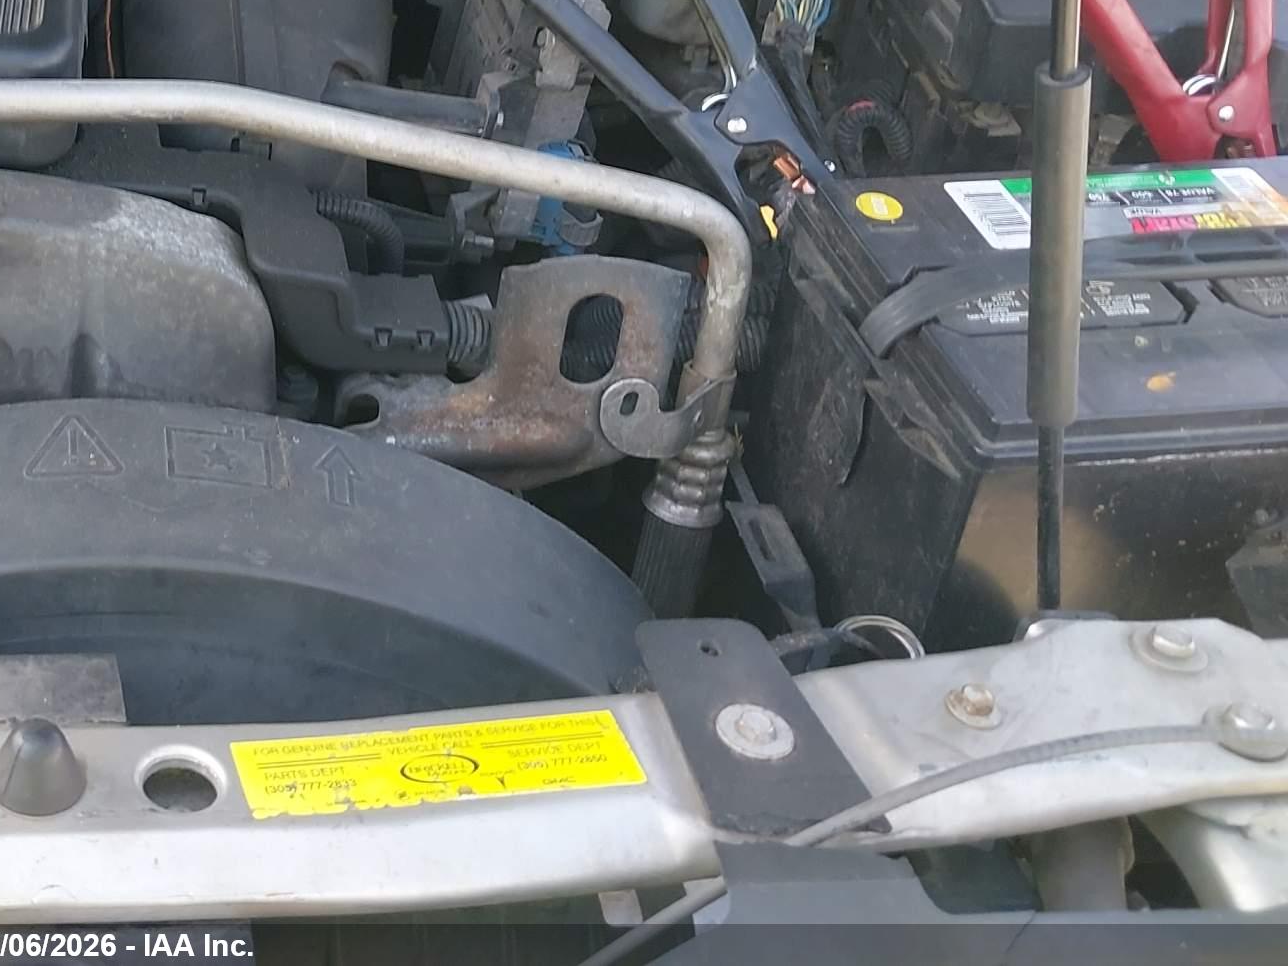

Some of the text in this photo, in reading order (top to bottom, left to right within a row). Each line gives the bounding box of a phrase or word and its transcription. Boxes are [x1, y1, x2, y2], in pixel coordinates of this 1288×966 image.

[253, 745, 279, 757] FOR
[281, 742, 338, 756] GENUINE
[387, 739, 473, 756] VEHICLE CALL
[507, 744, 564, 759] SERVICE
[264, 766, 308, 781] PARTS
